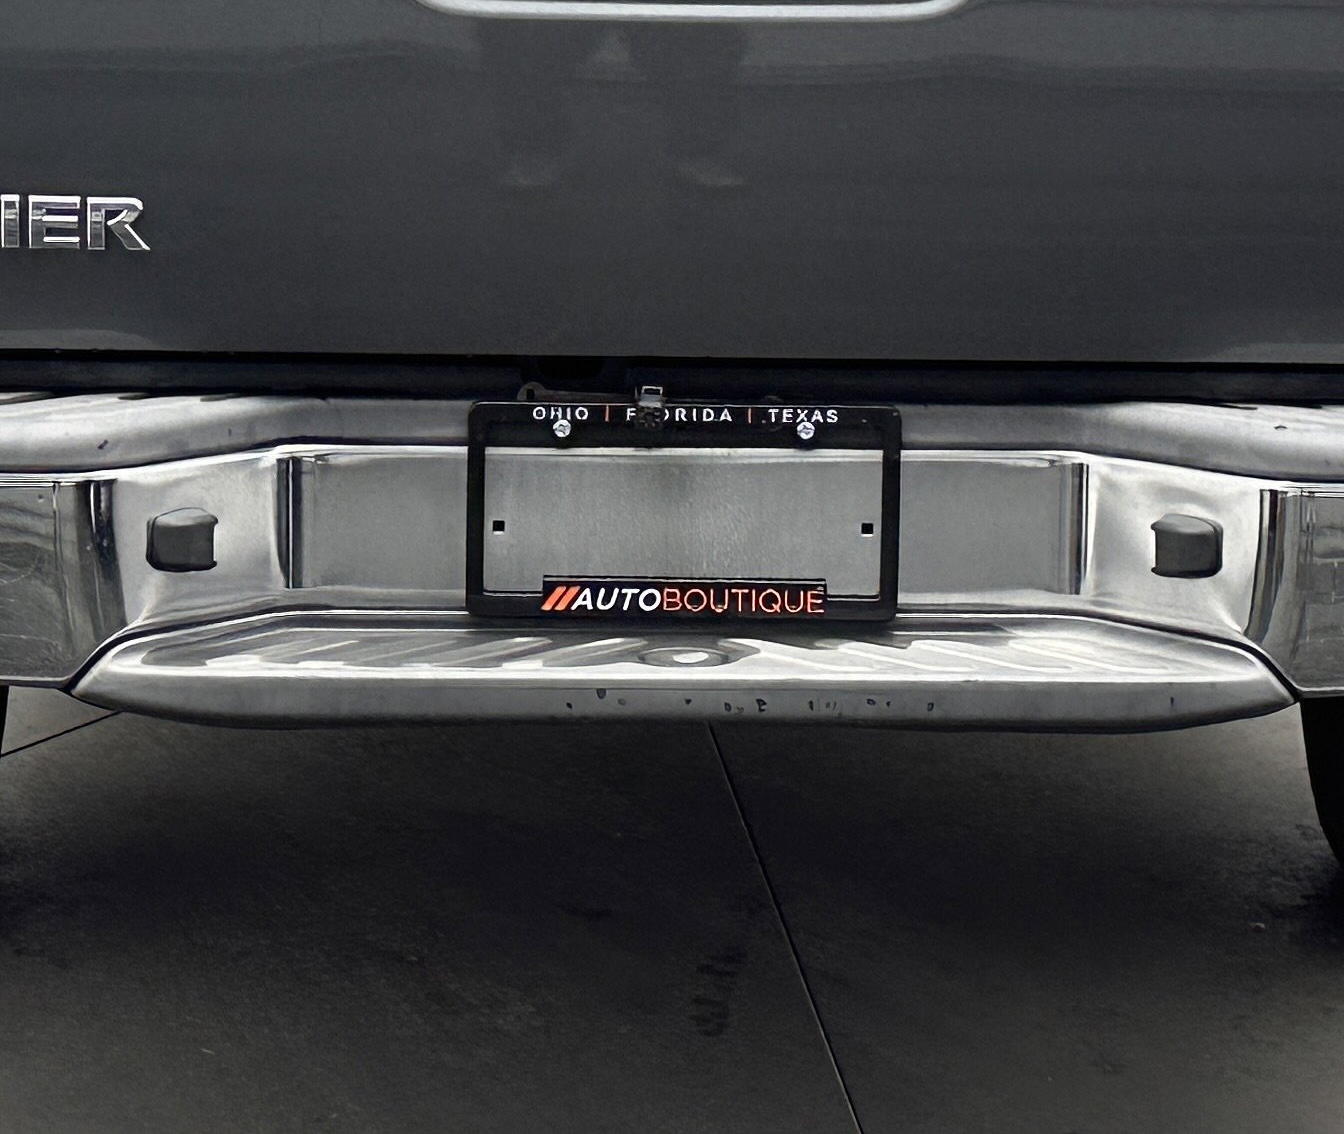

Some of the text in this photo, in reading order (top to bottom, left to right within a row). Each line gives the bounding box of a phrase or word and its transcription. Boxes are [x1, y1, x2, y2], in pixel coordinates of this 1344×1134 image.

[532, 406, 840, 423] OHIO FRIDA TEXAS
[571, 586, 826, 614] AUTOBOUTIQUE
